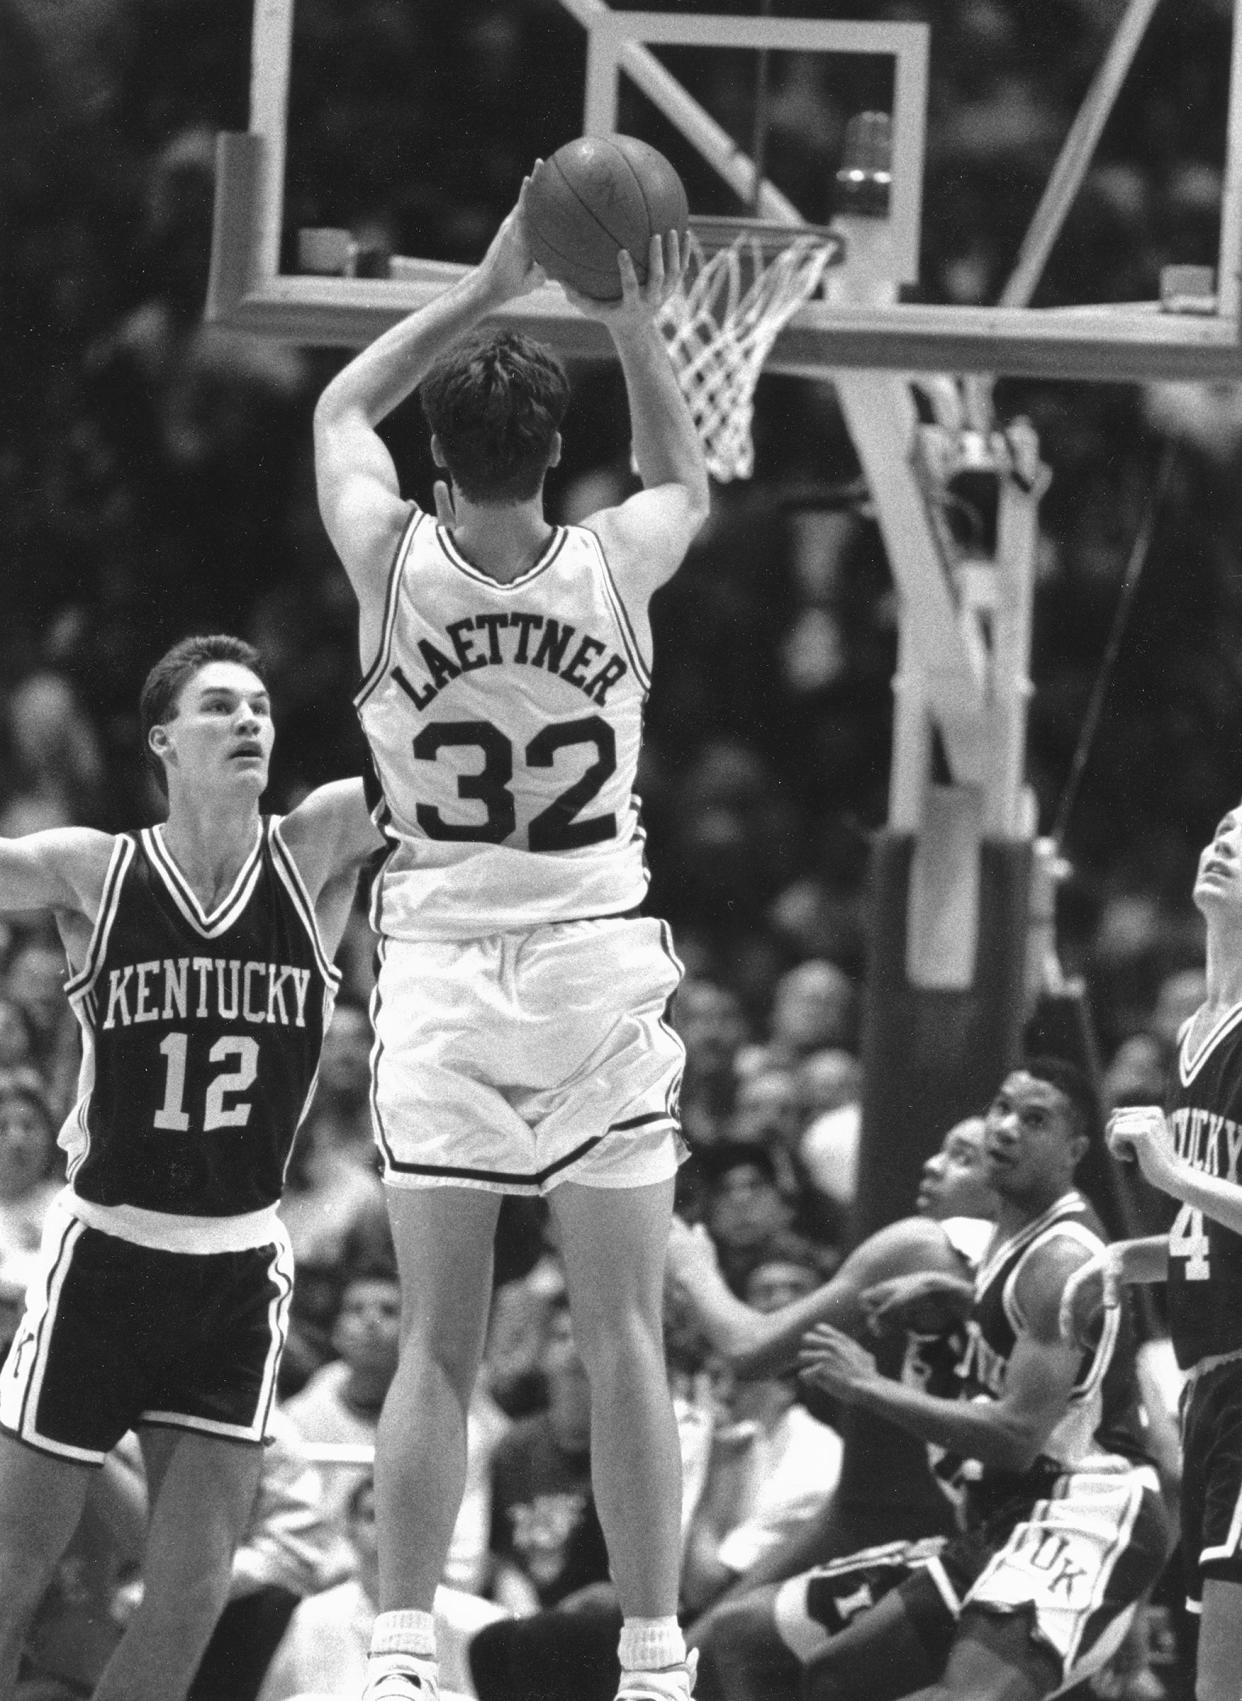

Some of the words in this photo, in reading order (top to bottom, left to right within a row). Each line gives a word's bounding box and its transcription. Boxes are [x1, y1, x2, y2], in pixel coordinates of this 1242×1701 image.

[390, 612, 628, 711] LAETTNER
[412, 715, 617, 852] 32
[102, 956, 311, 1030] KENTUCKY
[153, 1032, 260, 1132] 12
[1030, 1528, 1088, 1602] UK
